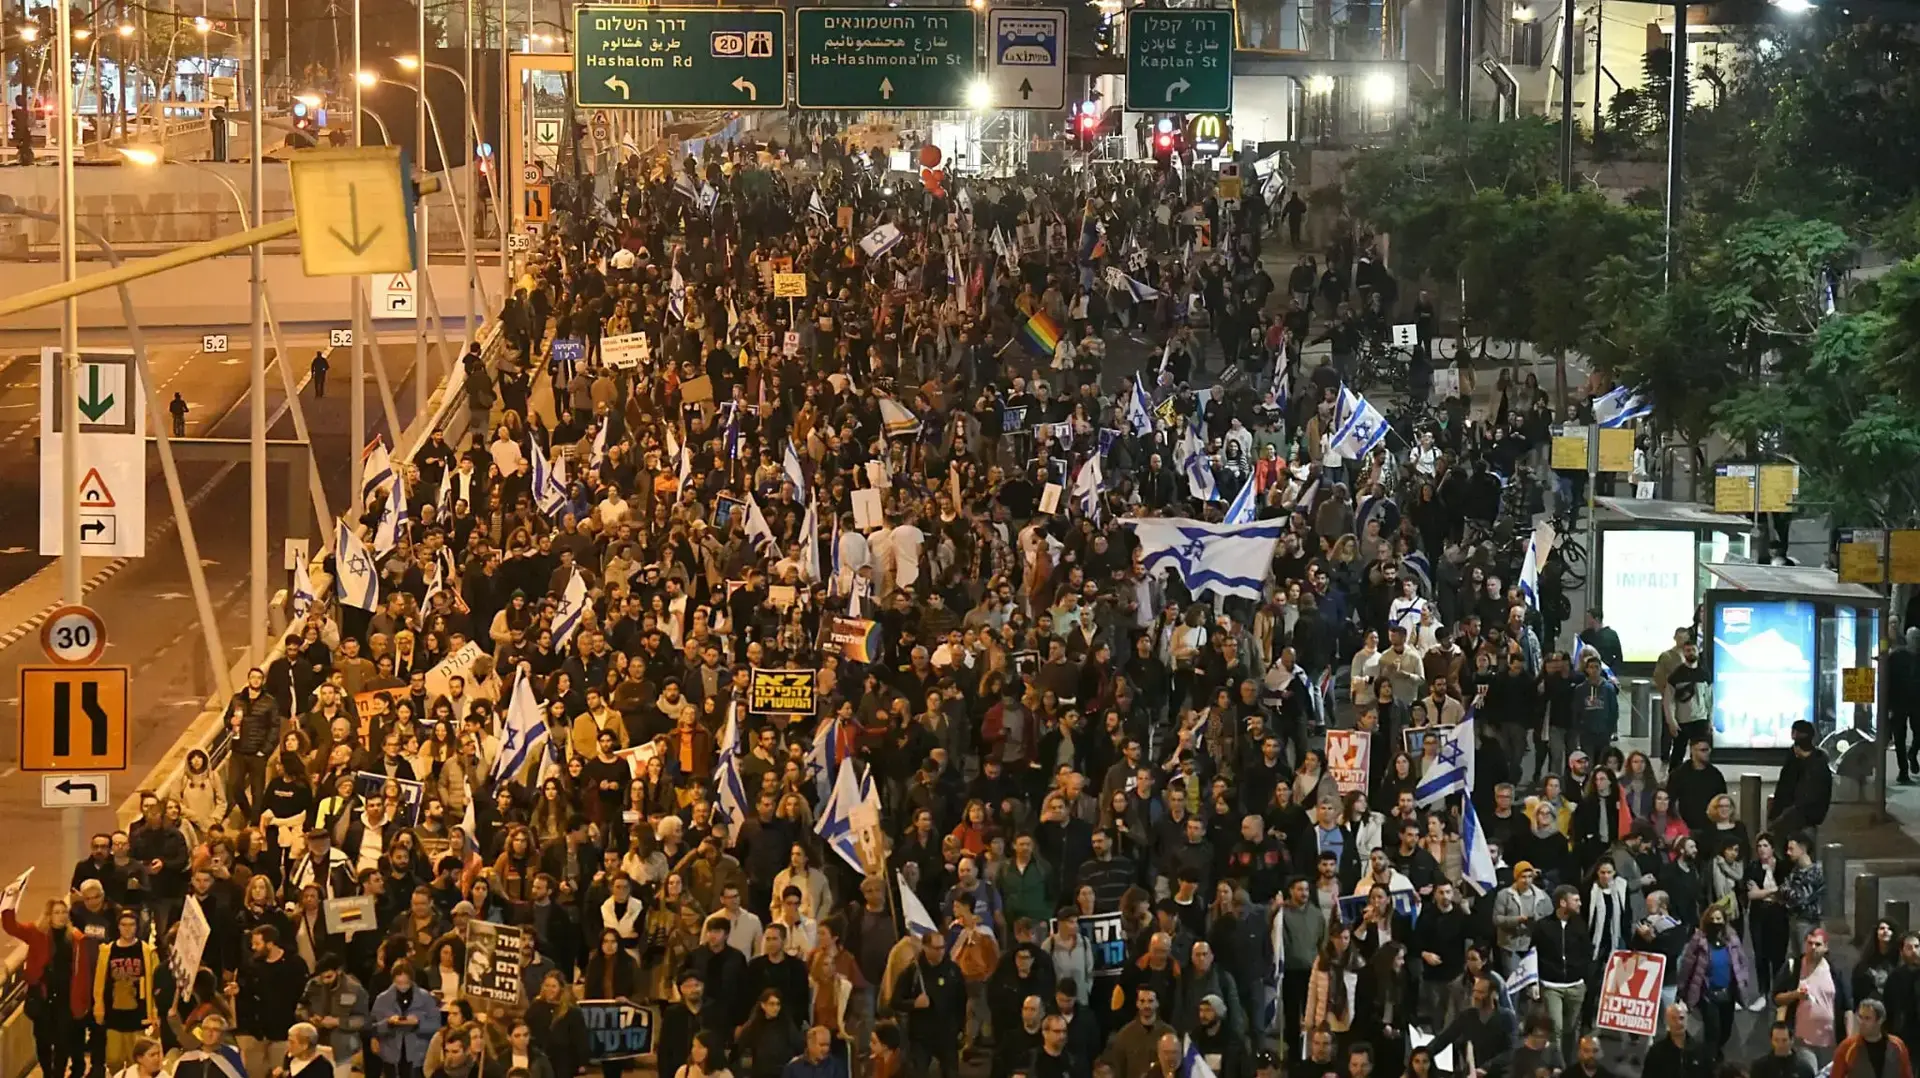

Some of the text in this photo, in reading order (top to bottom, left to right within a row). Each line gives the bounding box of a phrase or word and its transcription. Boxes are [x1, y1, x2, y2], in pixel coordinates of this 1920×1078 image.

[595, 16, 686, 34] דרך השלום
[824, 16, 915, 29] החשמונאים
[1144, 16, 1182, 34] קפלן
[649, 38, 681, 52] طريق
[720, 39, 738, 51] 20
[914, 36, 948, 52] شارع
[1185, 40, 1220, 54] شارع
[586, 55, 693, 67] Hashalom Rd
[811, 53, 962, 65] Ha-Hashmona'im St
[1140, 55, 1217, 69] Kaplan St
[525, 171, 537, 180] 30
[509, 236, 530, 247] 5.50
[205, 339, 225, 349] 5.2
[333, 333, 352, 344] 5.2
[1616, 572, 1680, 588] IMPACT
[57, 625, 91, 649] 30
[756, 673, 812, 686] לא
[755, 686, 812, 698] להפיכה
[754, 697, 812, 709] המשטרית
[1328, 733, 1367, 769] לא
[498, 934, 520, 949] מה
[495, 975, 518, 991] היו
[1606, 955, 1662, 999] לא
[1603, 995, 1655, 1017] להפיכה
